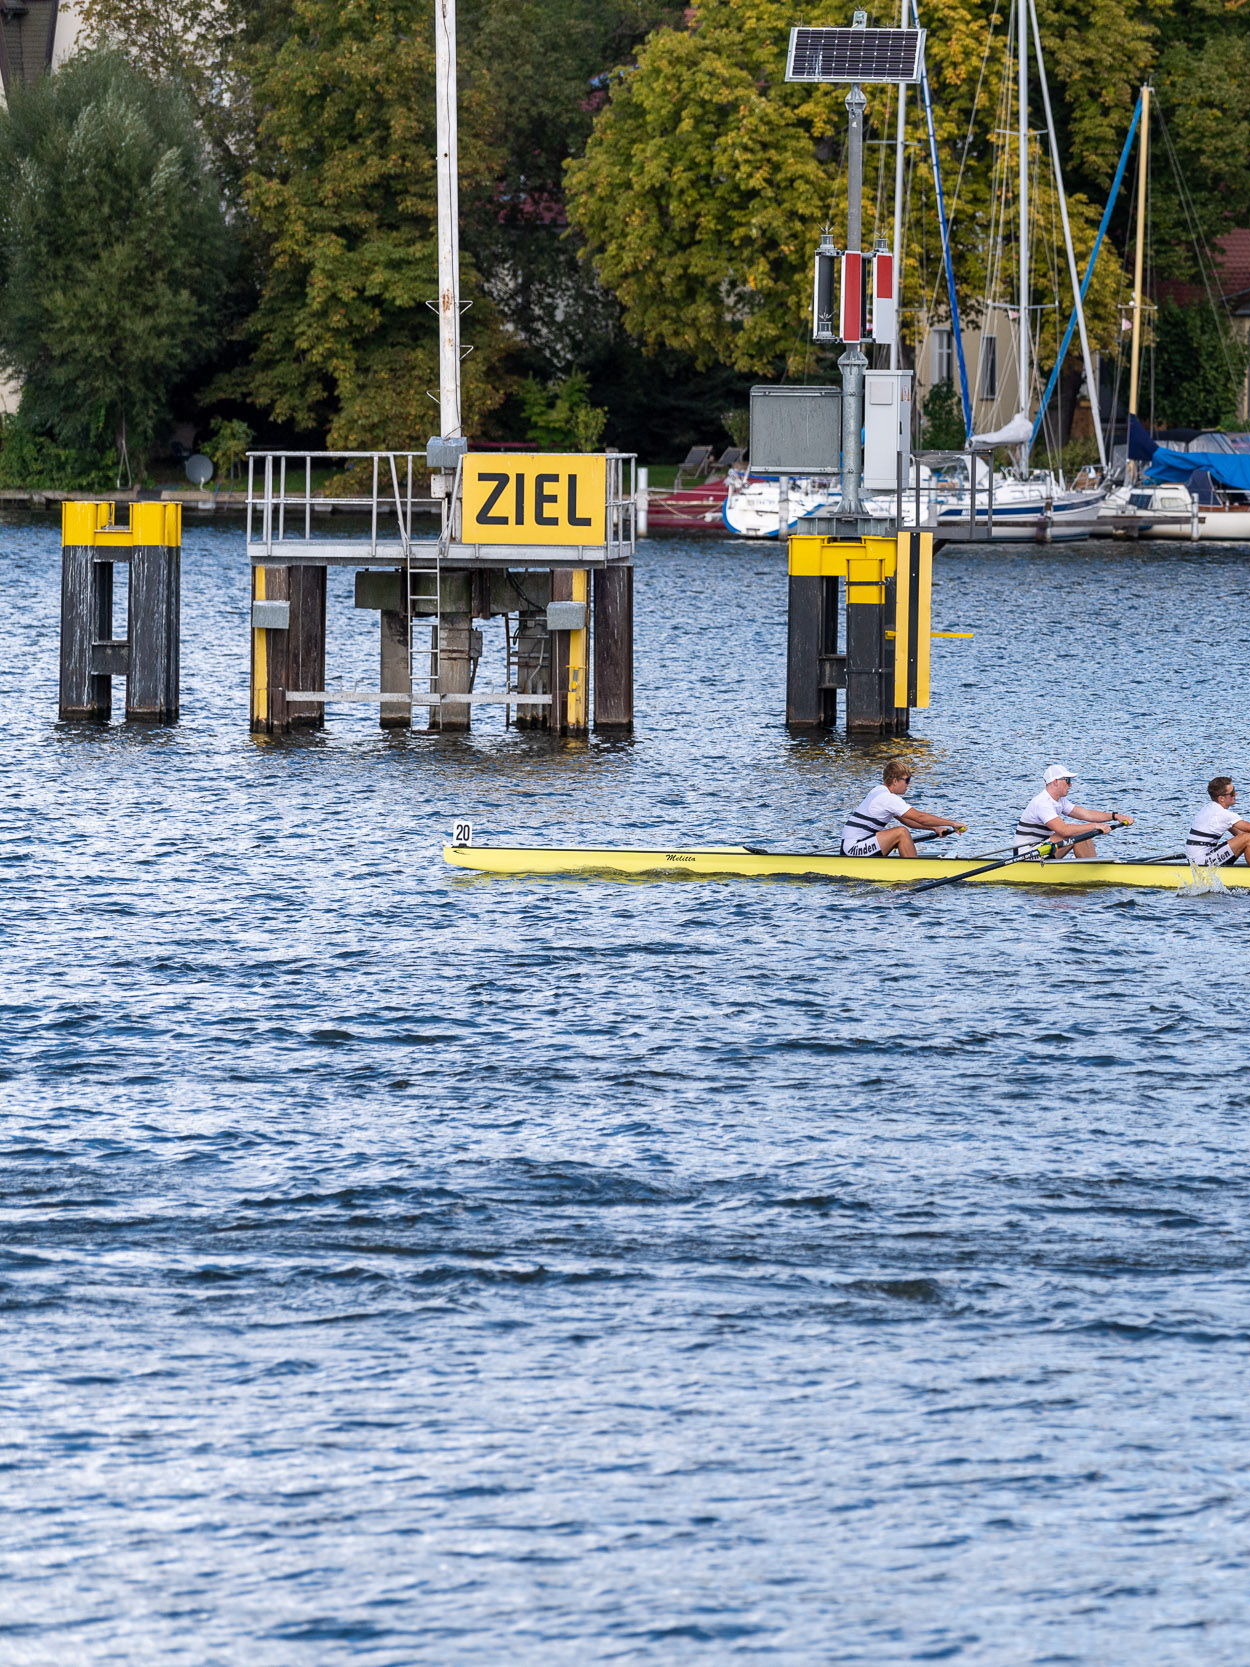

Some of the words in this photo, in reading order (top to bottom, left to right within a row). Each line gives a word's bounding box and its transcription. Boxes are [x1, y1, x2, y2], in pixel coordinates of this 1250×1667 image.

[476, 472, 592, 527] ZIEL
[456, 824, 471, 841] 20
[847, 842, 877, 856] Minden
[665, 854, 696, 862] Melitta
